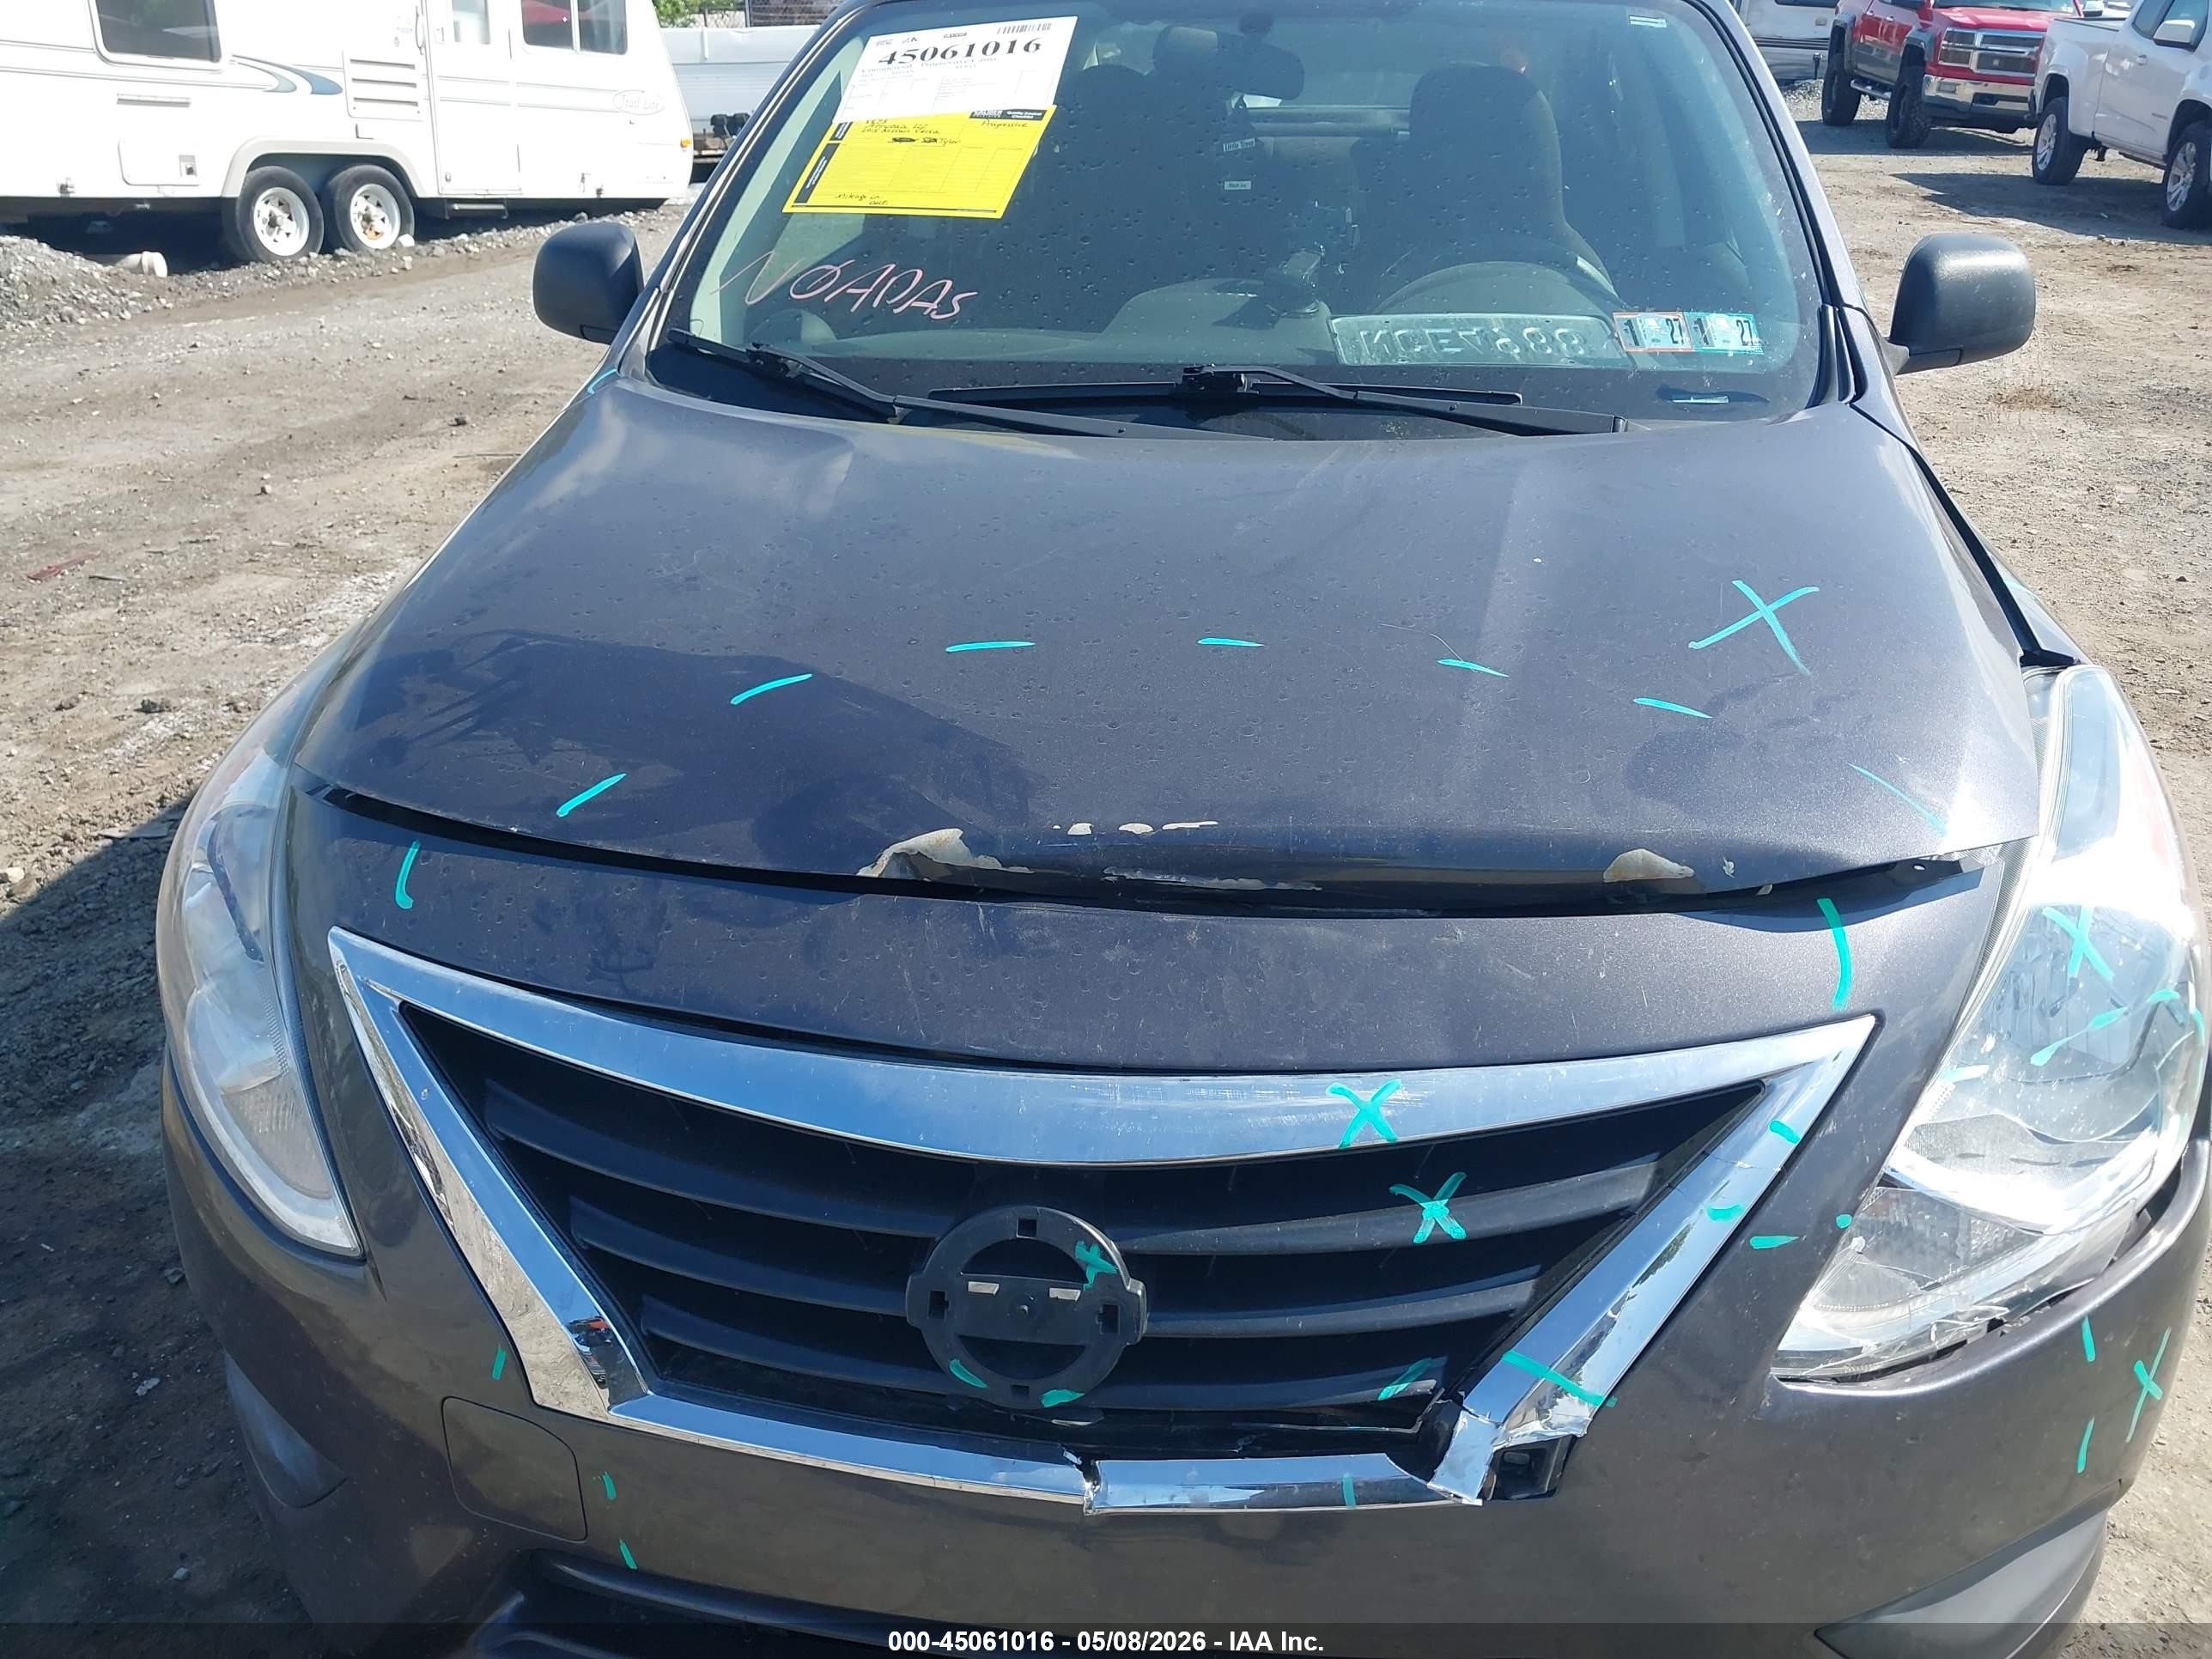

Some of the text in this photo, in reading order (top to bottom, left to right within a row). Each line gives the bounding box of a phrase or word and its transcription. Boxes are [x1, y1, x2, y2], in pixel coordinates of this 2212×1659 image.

[878, 37, 1042, 66] 45061016
[823, 263, 979, 320] ADAS
[1623, 317, 1685, 347] 1 27
[1693, 317, 1754, 347] 1 27
